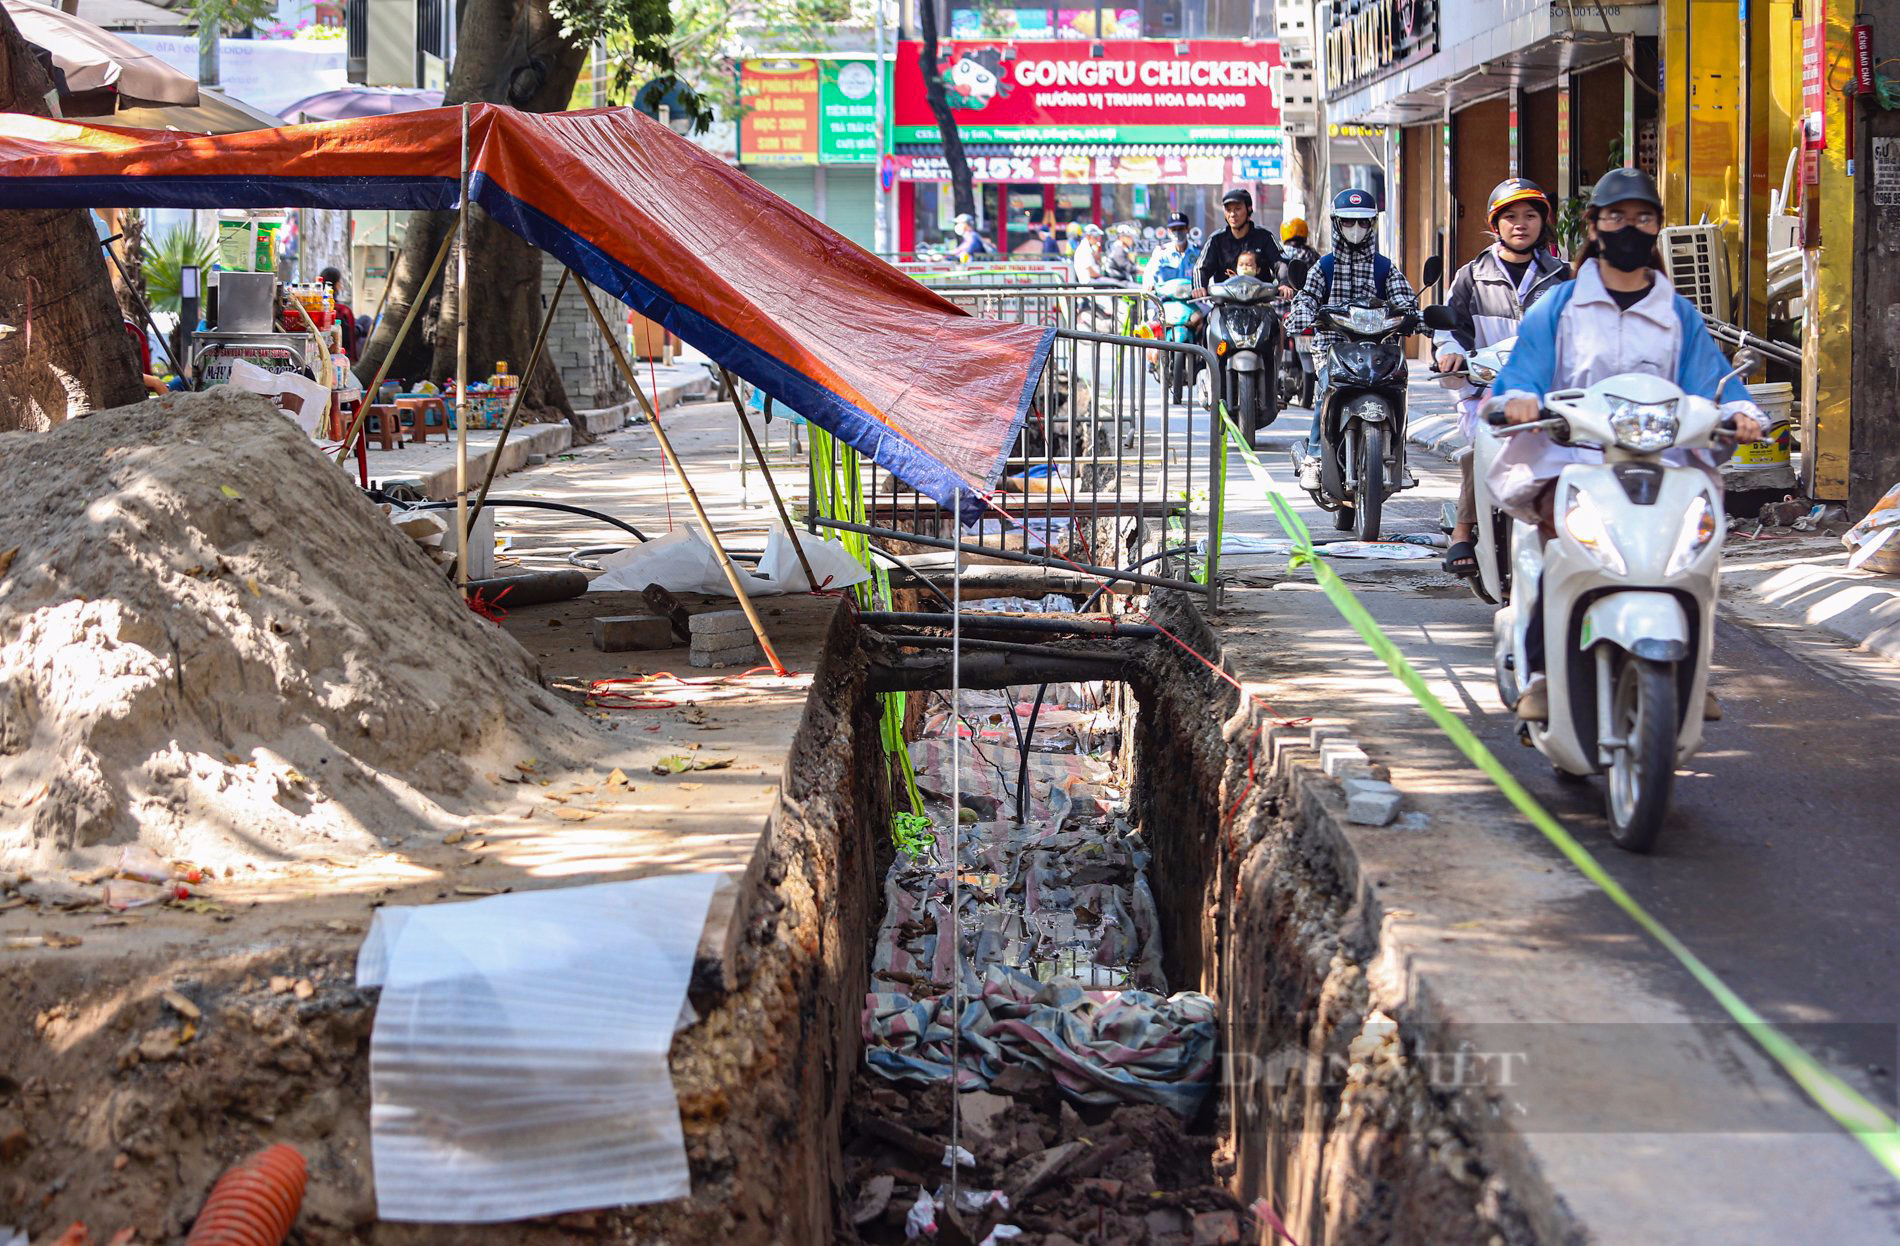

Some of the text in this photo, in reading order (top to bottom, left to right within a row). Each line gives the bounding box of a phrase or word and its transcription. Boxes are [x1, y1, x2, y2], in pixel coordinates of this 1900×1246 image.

[1014, 60, 1270, 87] GONGFU CHICKEN
[972, 157, 1035, 179] 15%
